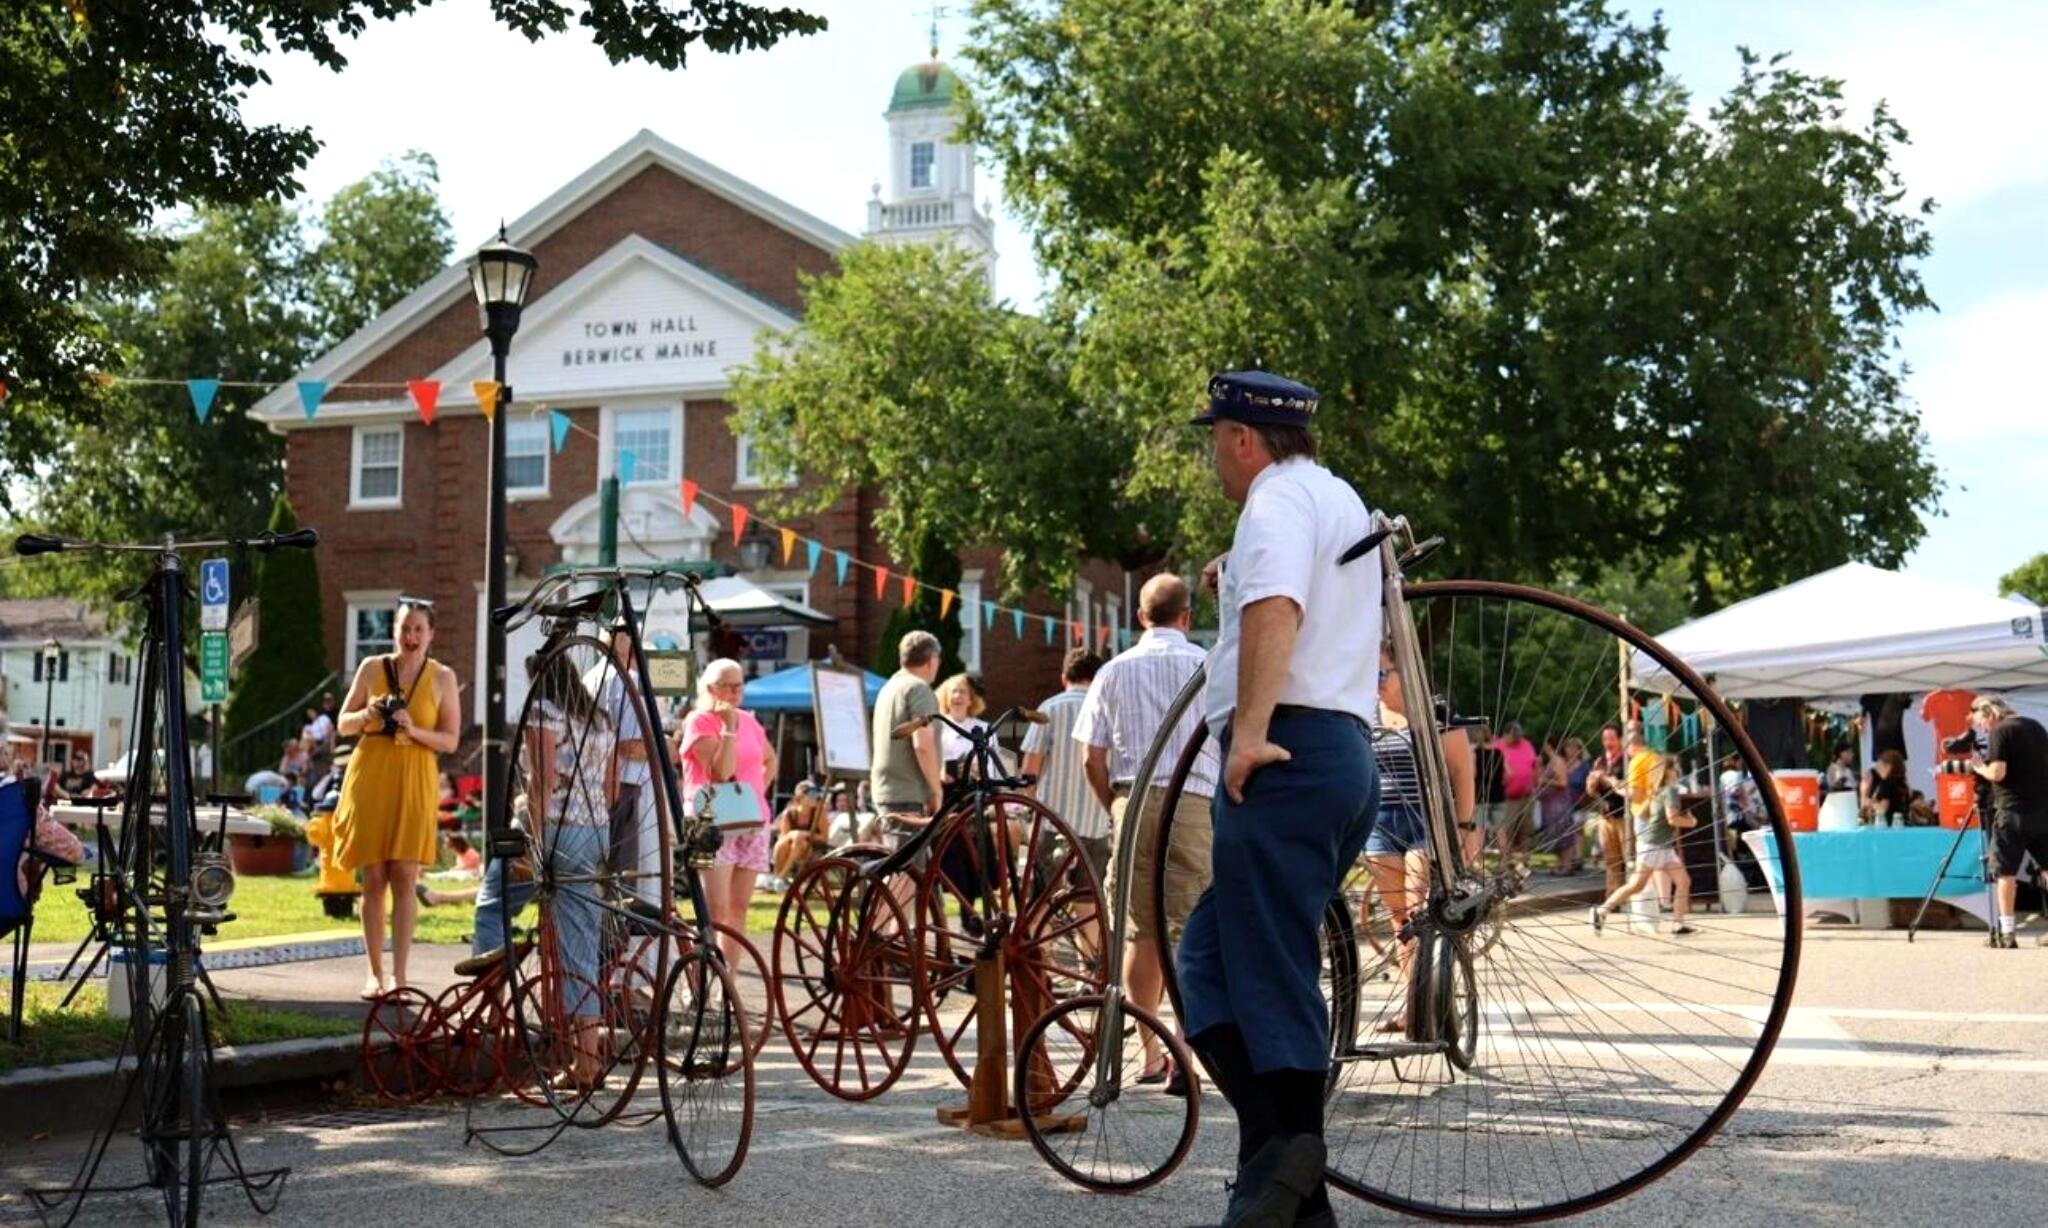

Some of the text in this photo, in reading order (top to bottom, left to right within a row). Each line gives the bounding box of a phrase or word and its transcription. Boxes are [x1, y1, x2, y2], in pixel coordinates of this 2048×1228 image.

[585, 316, 697, 337] TOWN HALL
[563, 341, 716, 366] BERWICK MAINE
